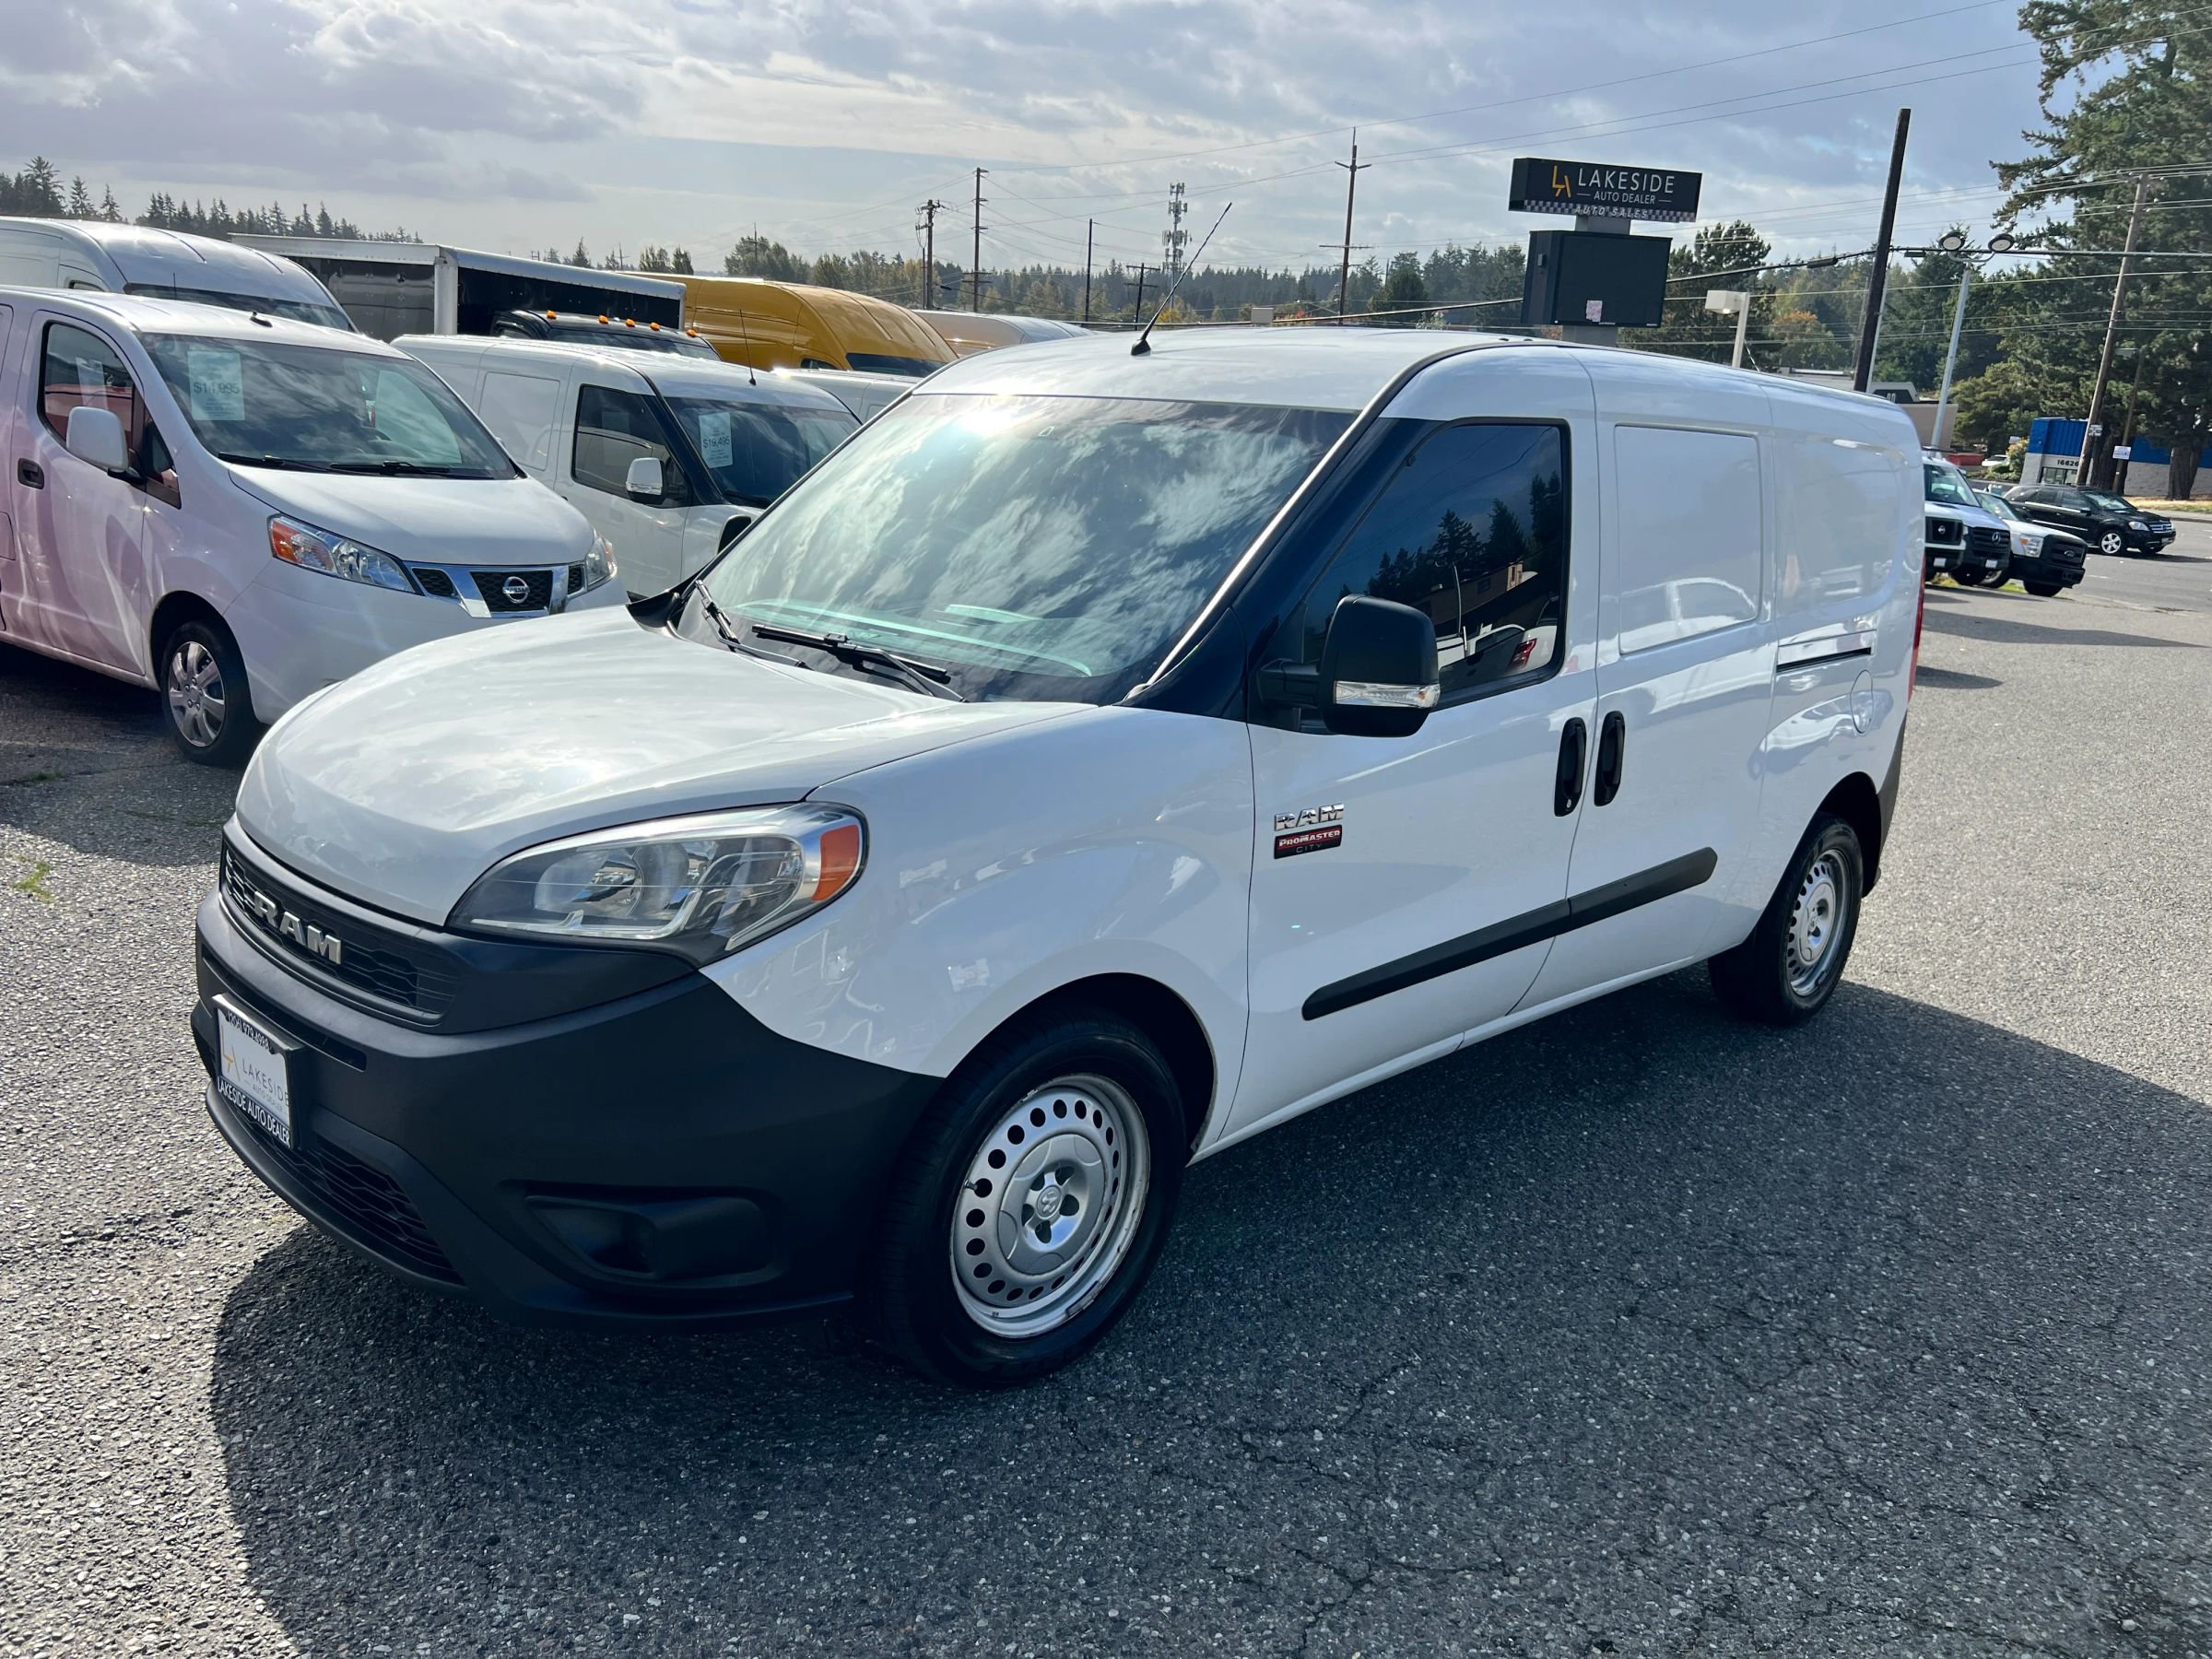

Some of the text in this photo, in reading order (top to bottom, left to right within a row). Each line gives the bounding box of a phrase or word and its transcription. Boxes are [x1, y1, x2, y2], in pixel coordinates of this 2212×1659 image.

[1578, 168, 1676, 194] LAKESIDE
[1594, 190, 1656, 205] AUTO DEALER
[1575, 205, 1649, 218] AUTO SALES
[1275, 803, 1345, 831] RAM
[1296, 843, 1322, 853] CITY
[254, 890, 341, 965] RAM
[242, 1059, 289, 1107] LAKESIDE
[218, 1076, 290, 1148] LAKESIDE AUTO DEALER
